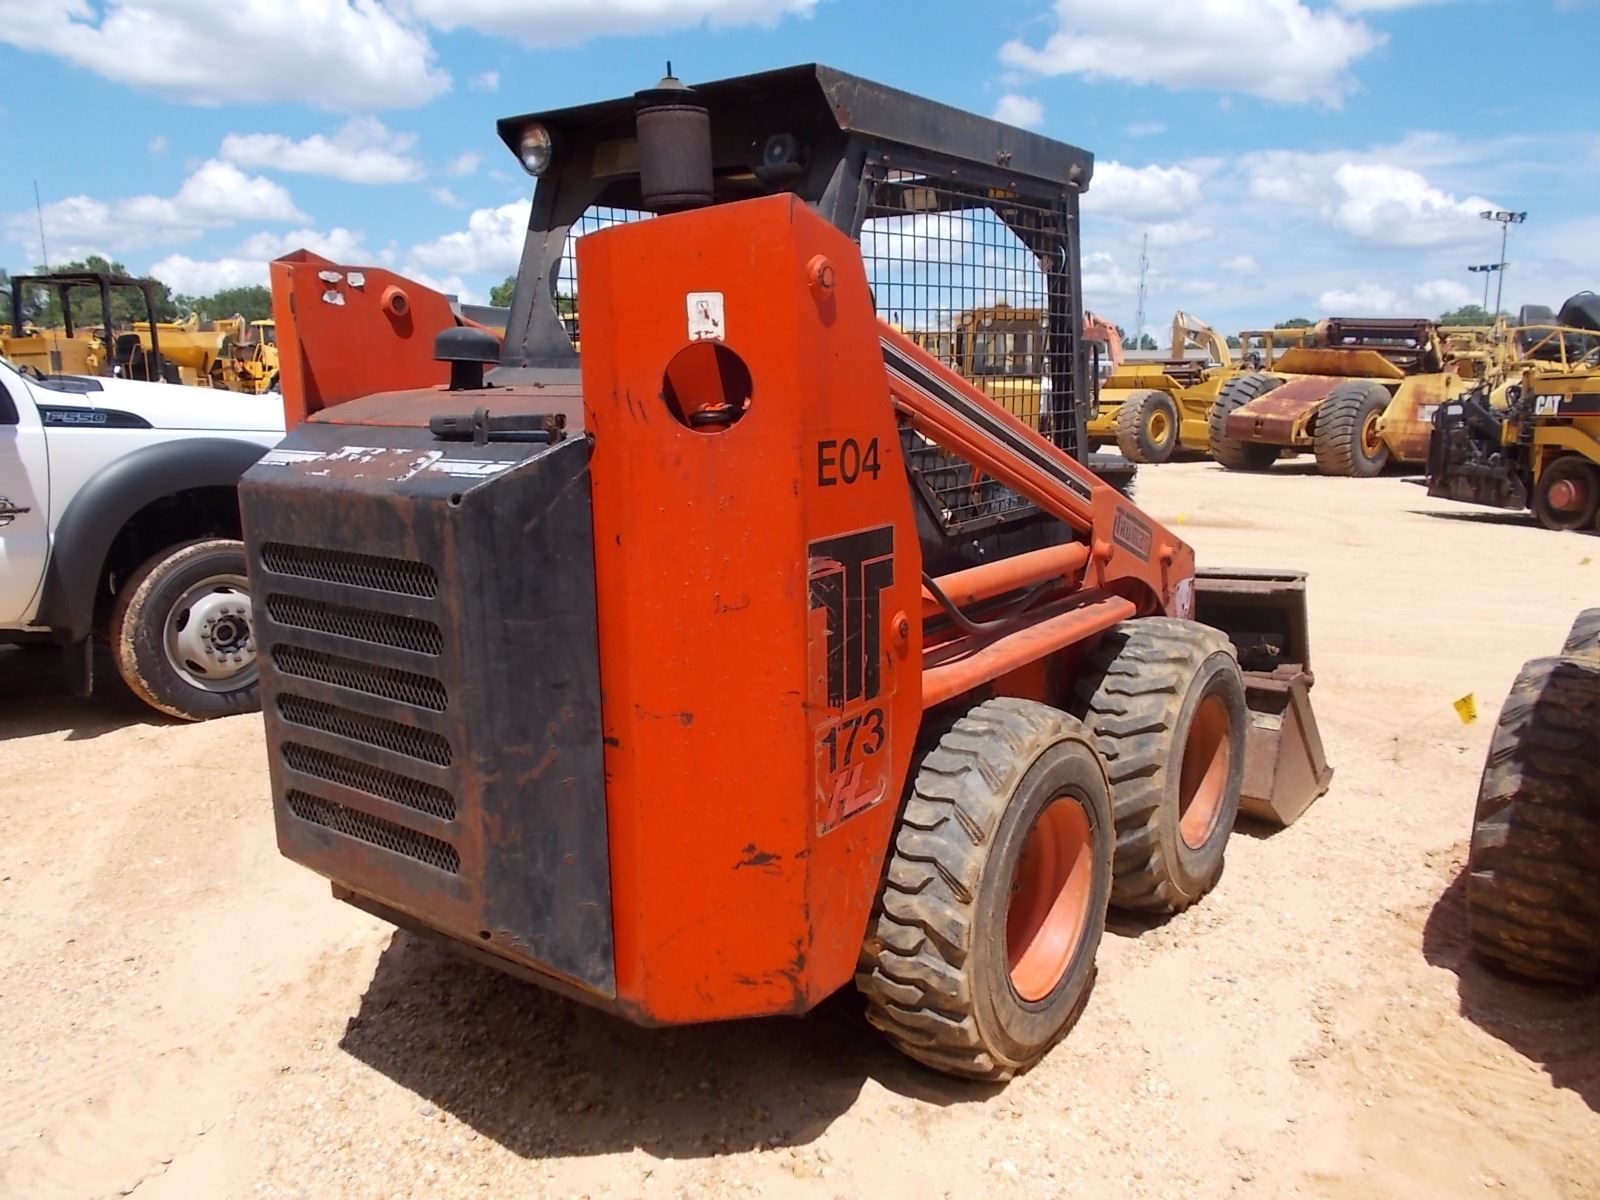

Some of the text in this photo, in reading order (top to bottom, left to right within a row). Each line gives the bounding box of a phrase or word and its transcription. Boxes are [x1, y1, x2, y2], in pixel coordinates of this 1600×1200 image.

[1535, 395, 1561, 416] CAT
[818, 437, 881, 487] E04
[821, 707, 885, 774] 173
